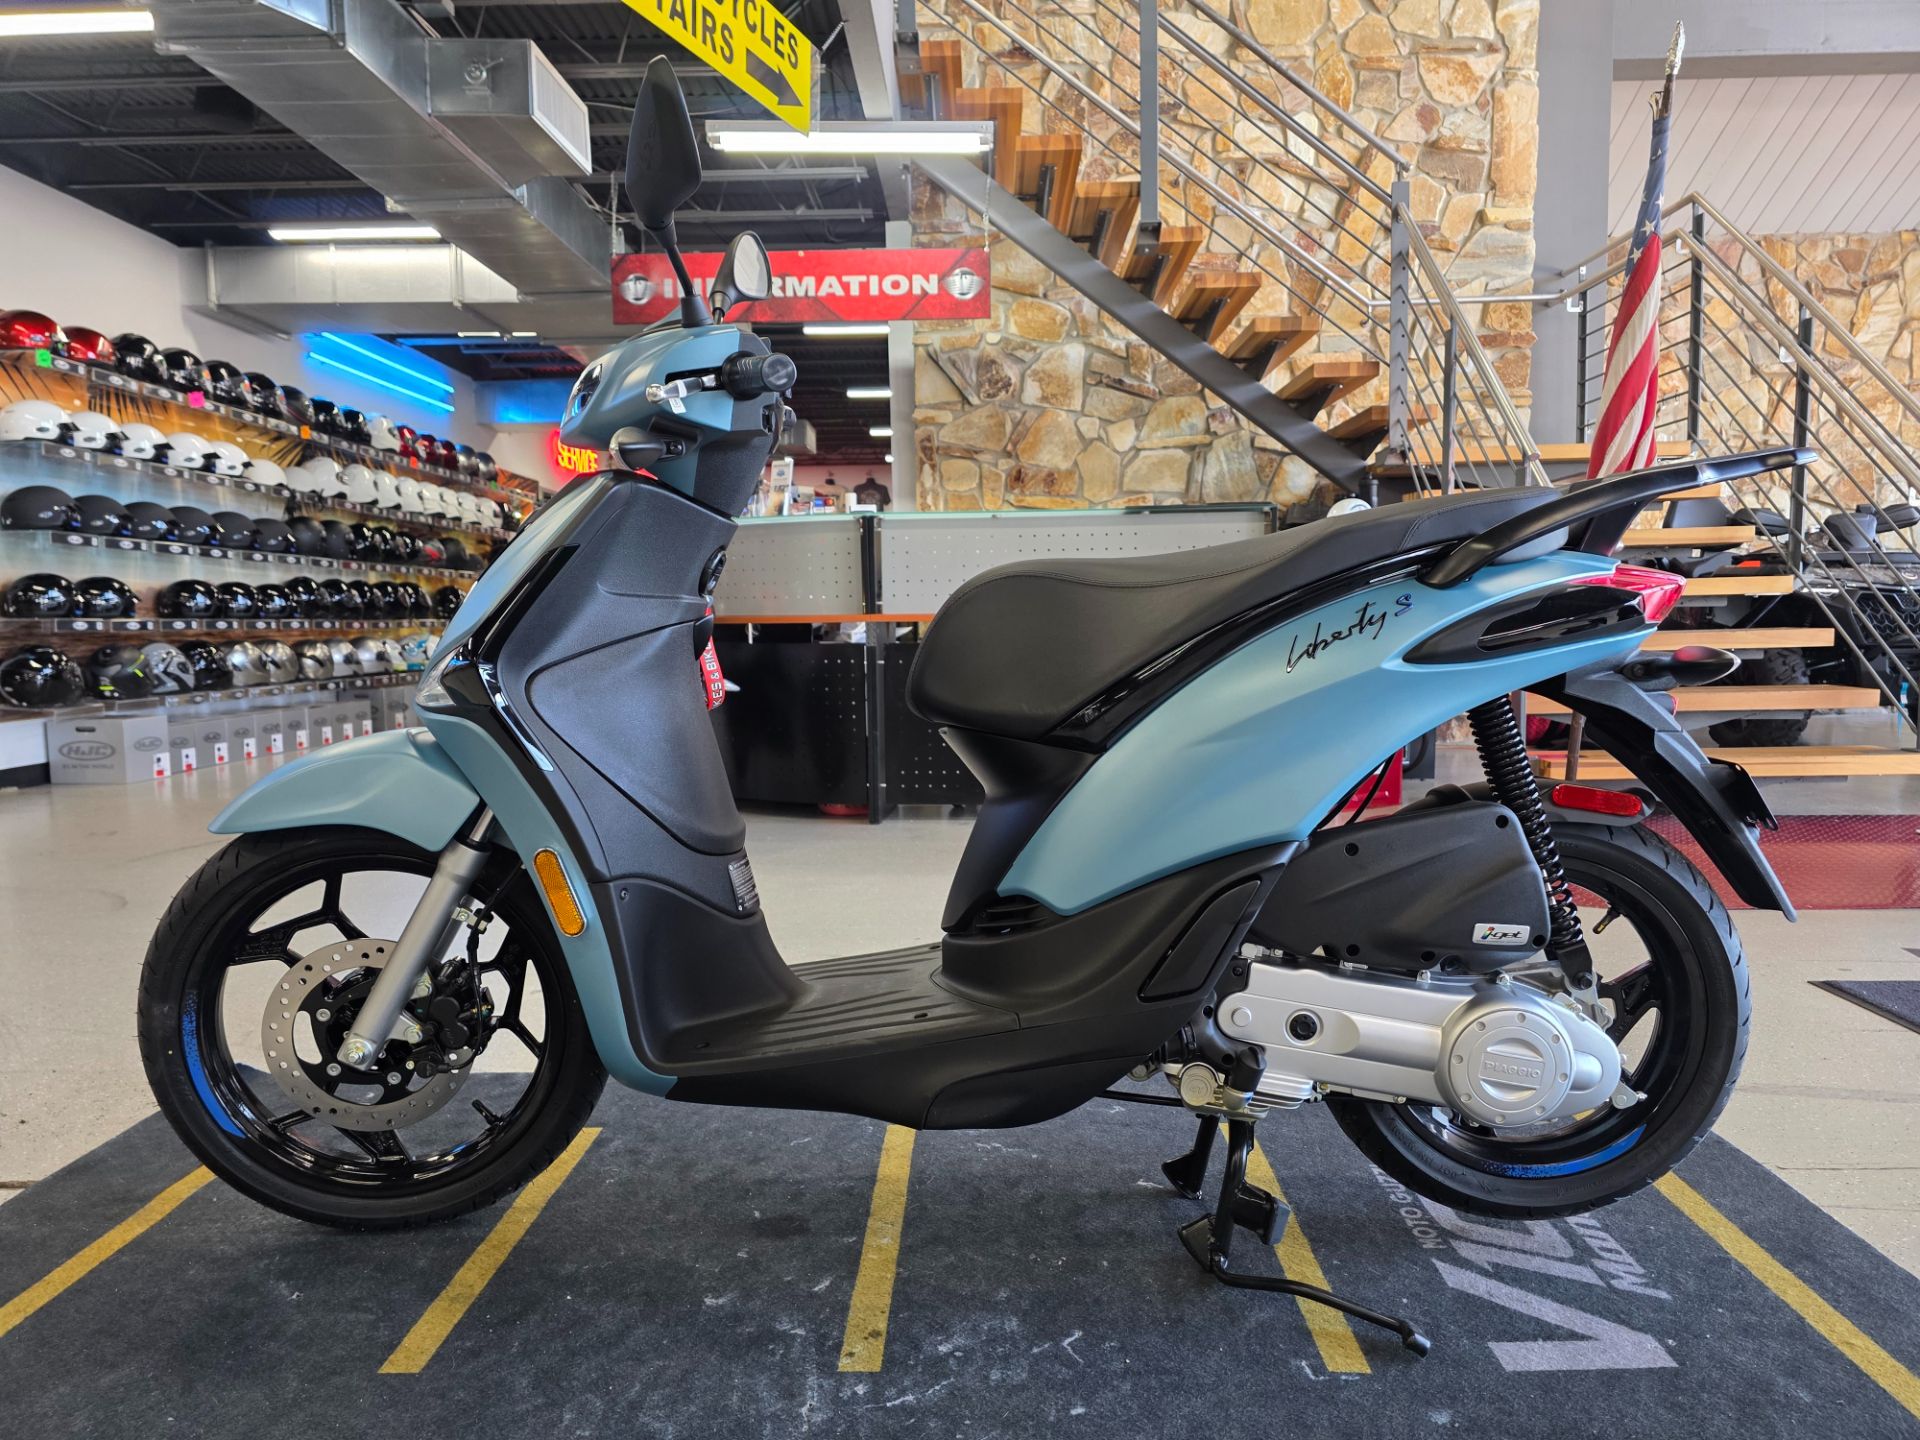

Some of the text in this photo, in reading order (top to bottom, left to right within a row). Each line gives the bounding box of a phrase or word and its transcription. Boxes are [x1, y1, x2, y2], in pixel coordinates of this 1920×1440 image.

[663, 274, 939, 299] INRMATION
[1286, 593, 1413, 673] Liberty S
[67, 745, 108, 756] HJC
[1485, 1060, 1541, 1079] PIAGGIO
[1399, 1207, 1448, 1249] MOTO
